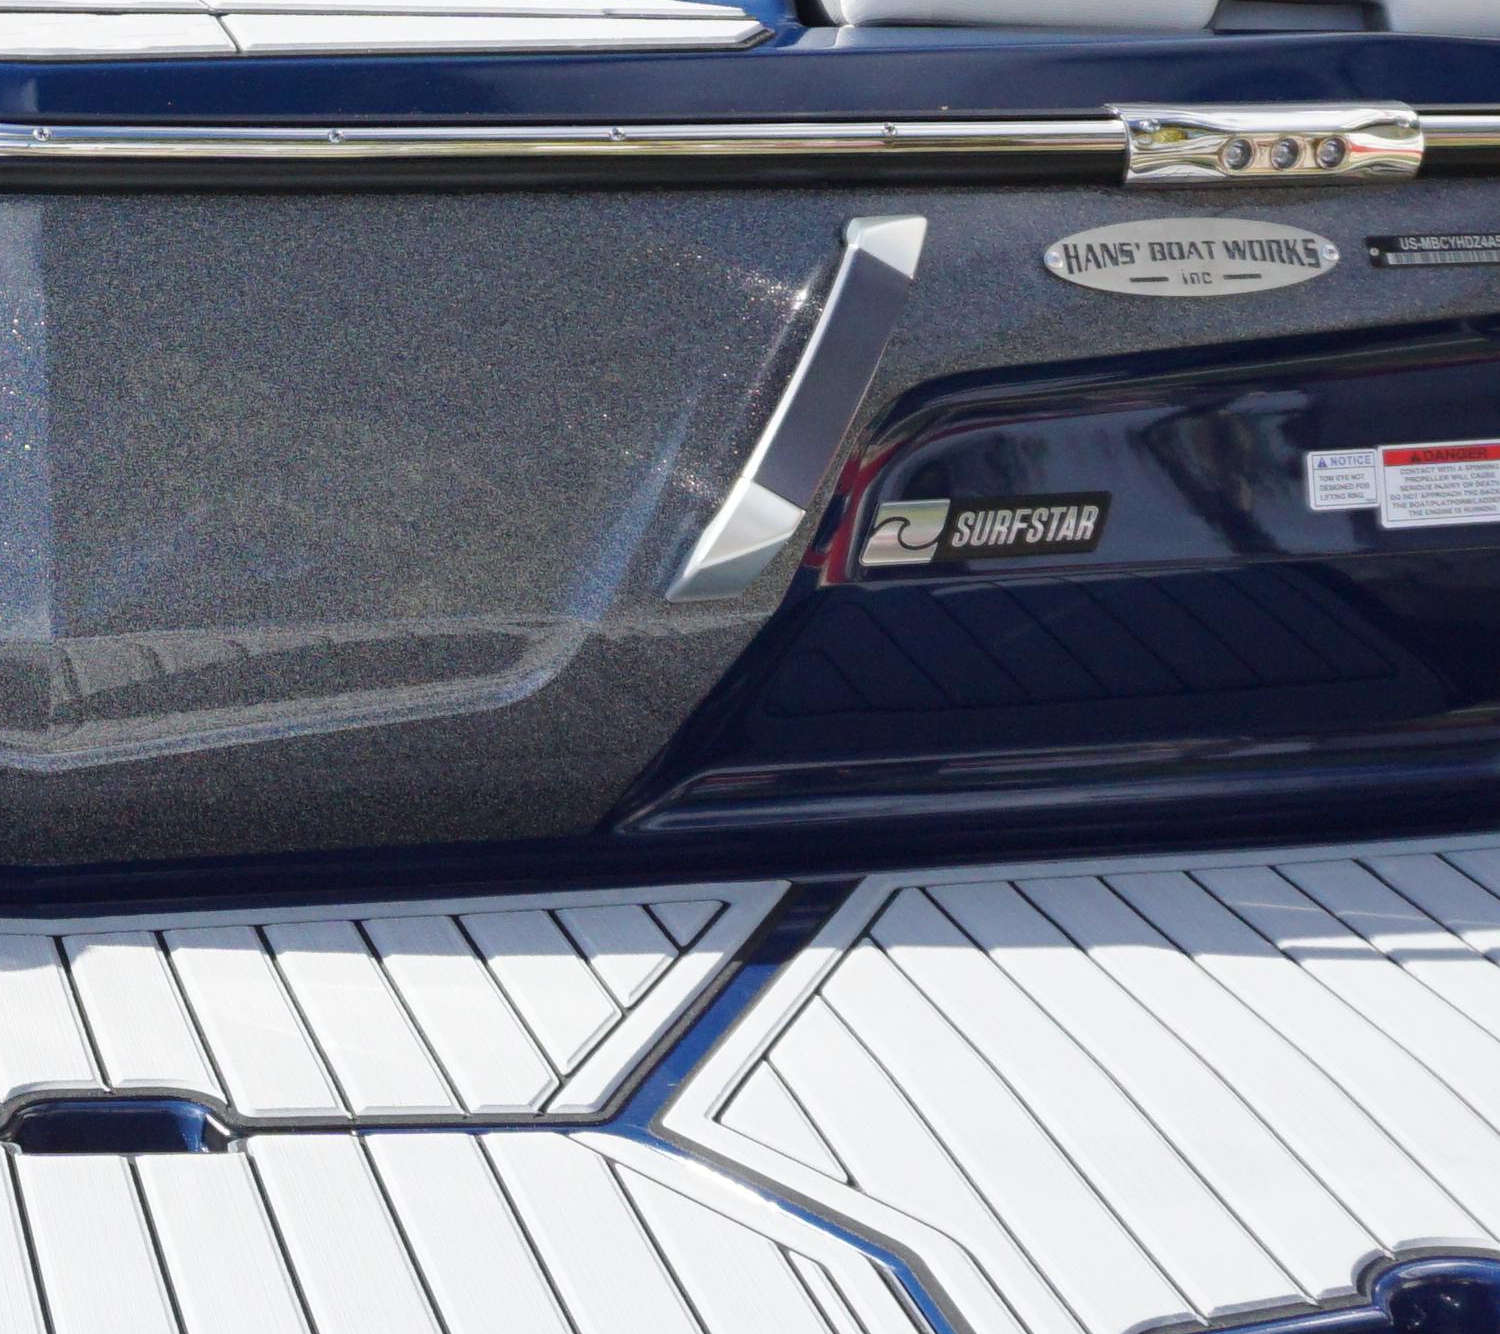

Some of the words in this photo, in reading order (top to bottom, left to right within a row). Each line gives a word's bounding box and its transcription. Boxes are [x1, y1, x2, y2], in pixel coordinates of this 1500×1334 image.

[1062, 241, 1141, 275] HANS'
[1147, 240, 1217, 262] BOAT
[1223, 238, 1322, 269] WORKS
[1181, 268, 1214, 285] inc
[1330, 455, 1372, 467] NOTICE
[1423, 448, 1488, 462] DANGER
[951, 505, 1099, 548] SURFSTAR
